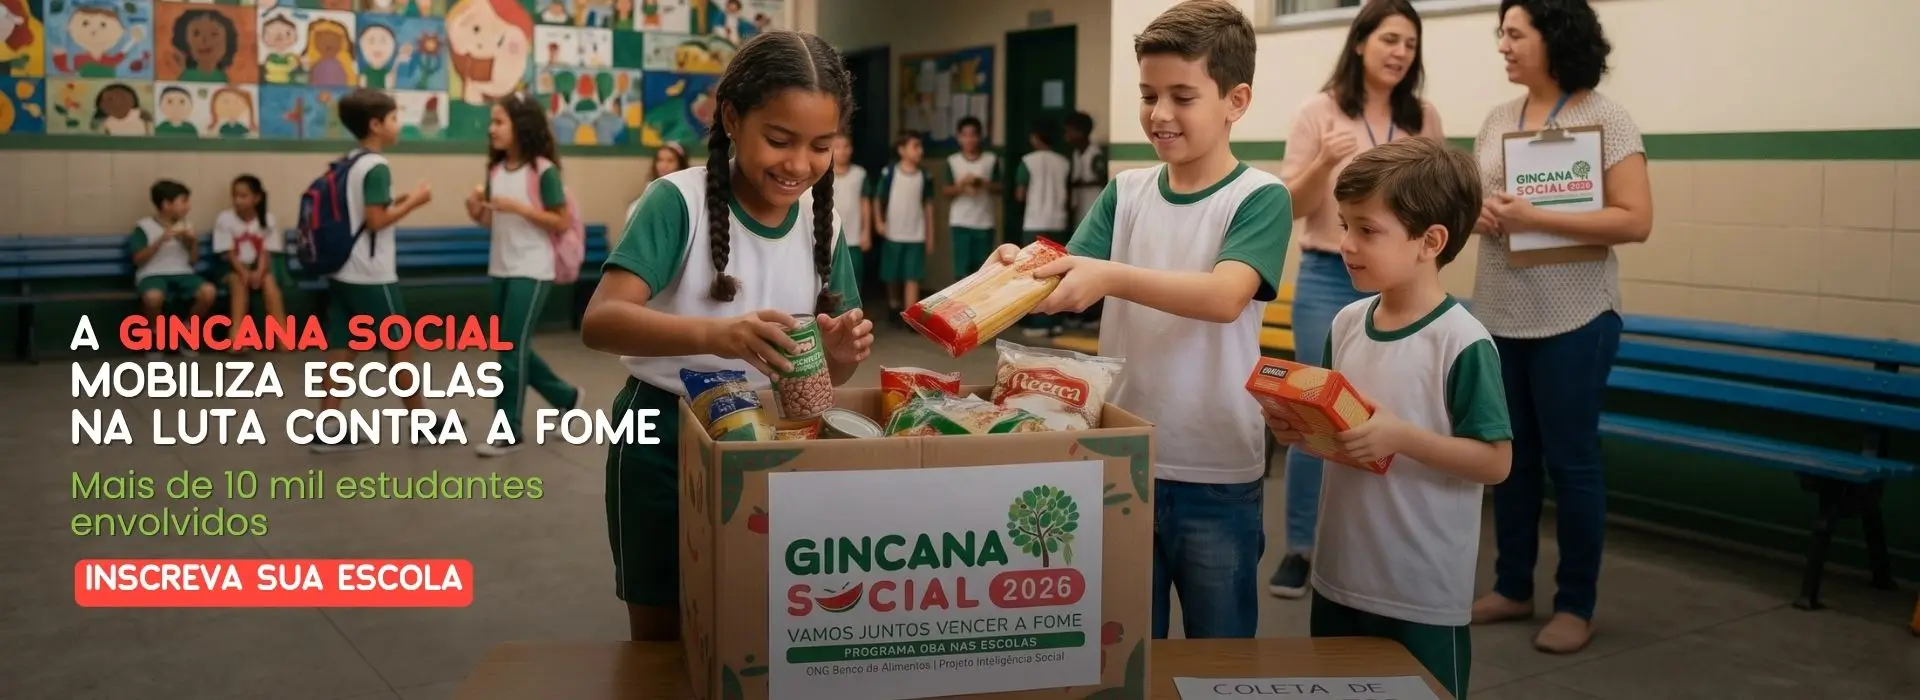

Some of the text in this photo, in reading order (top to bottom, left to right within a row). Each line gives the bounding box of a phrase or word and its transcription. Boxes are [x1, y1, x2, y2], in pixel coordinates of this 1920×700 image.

[1516, 171, 1573, 184] GINCANA
[1517, 183, 1565, 196] SOCIAL
[785, 530, 1008, 576] GINCANA
[1003, 576, 1071, 601] 2026
[787, 613, 1082, 642] VAMOS JUNTOS VENCER A FOME
[844, 637, 1037, 658] PROGRAMA OBA NAS ESCOLAS
[882, 659, 931, 672] Alimentos
[939, 658, 974, 671] Projeto
[1035, 651, 1065, 663] Social
[1213, 682, 1387, 696] COLETA DE
